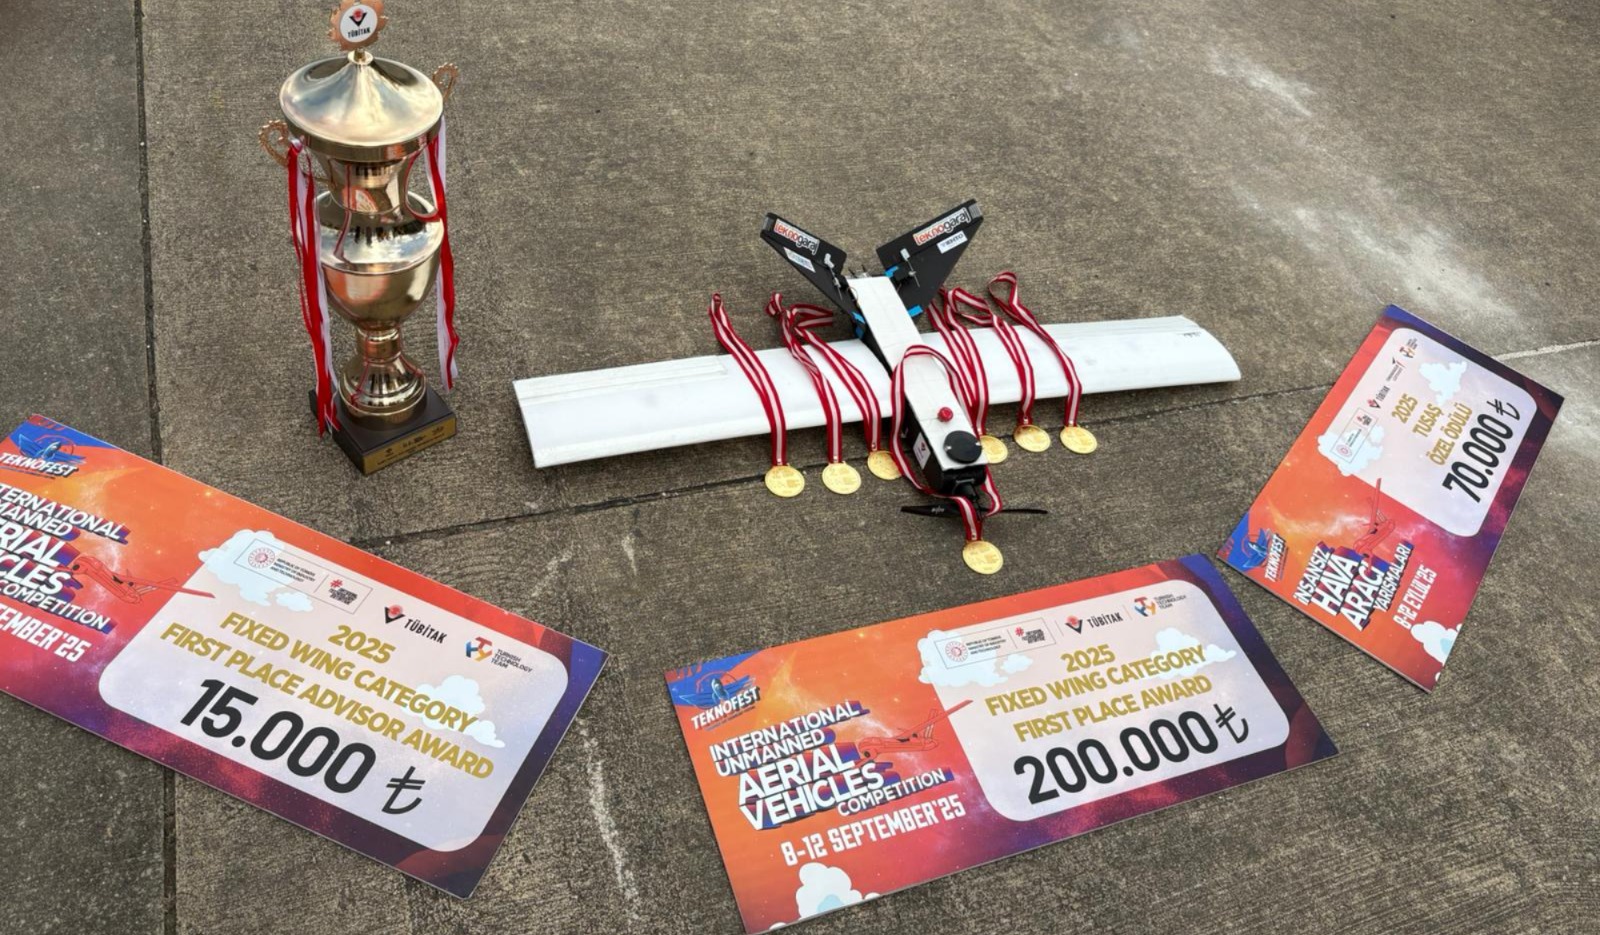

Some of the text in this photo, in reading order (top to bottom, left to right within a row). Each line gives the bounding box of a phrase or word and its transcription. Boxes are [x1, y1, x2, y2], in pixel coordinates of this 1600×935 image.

[348, 27, 371, 38] TÜBİTAK
[915, 209, 970, 244] teknogaraj
[1392, 393, 1418, 424] 2025
[1413, 403, 1444, 437] TUSAŞ
[1426, 402, 1473, 466] ÖZEL ÖDÜLÜ
[1442, 413, 1513, 503] 70.000
[0, 452, 77, 476] TEKNOFEST
[0, 518, 66, 567] RIAL
[1265, 534, 1286, 582] TEKNOFEST
[1293, 546, 1329, 605] İNSANSIZ
[1311, 553, 1359, 616] HAVA
[1340, 559, 1385, 631] ARACI
[404, 619, 447, 644] TÜBİTAK
[1087, 612, 1123, 628] TÜBİTAK
[1393, 608, 1418, 630] 8-12
[328, 625, 395, 664] 2025
[491, 658, 509, 669] TEAM
[494, 654, 533, 673] TECHNOLOGY
[1060, 644, 1116, 672] 2025
[219, 612, 478, 733] FIXED WING CATEGORY
[985, 644, 1207, 717] FIXED WING CATEGORY
[160, 622, 494, 779] FIRST PLACE ADVISOR AWARD
[691, 686, 757, 730] TEKNOFEST
[1013, 674, 1213, 742] FIRST PLACE AWARD
[180, 678, 376, 794] 15.000
[709, 700, 861, 762] INTERNATIONAL
[715, 728, 826, 777] UNMANNED
[738, 743, 856, 806] AERIAL
[1013, 710, 1218, 805] 200.000
[739, 761, 885, 830] VEHICLES
[837, 769, 947, 817] COMPETITION
[780, 793, 967, 867] 8-12 SEPTEMBER'25
